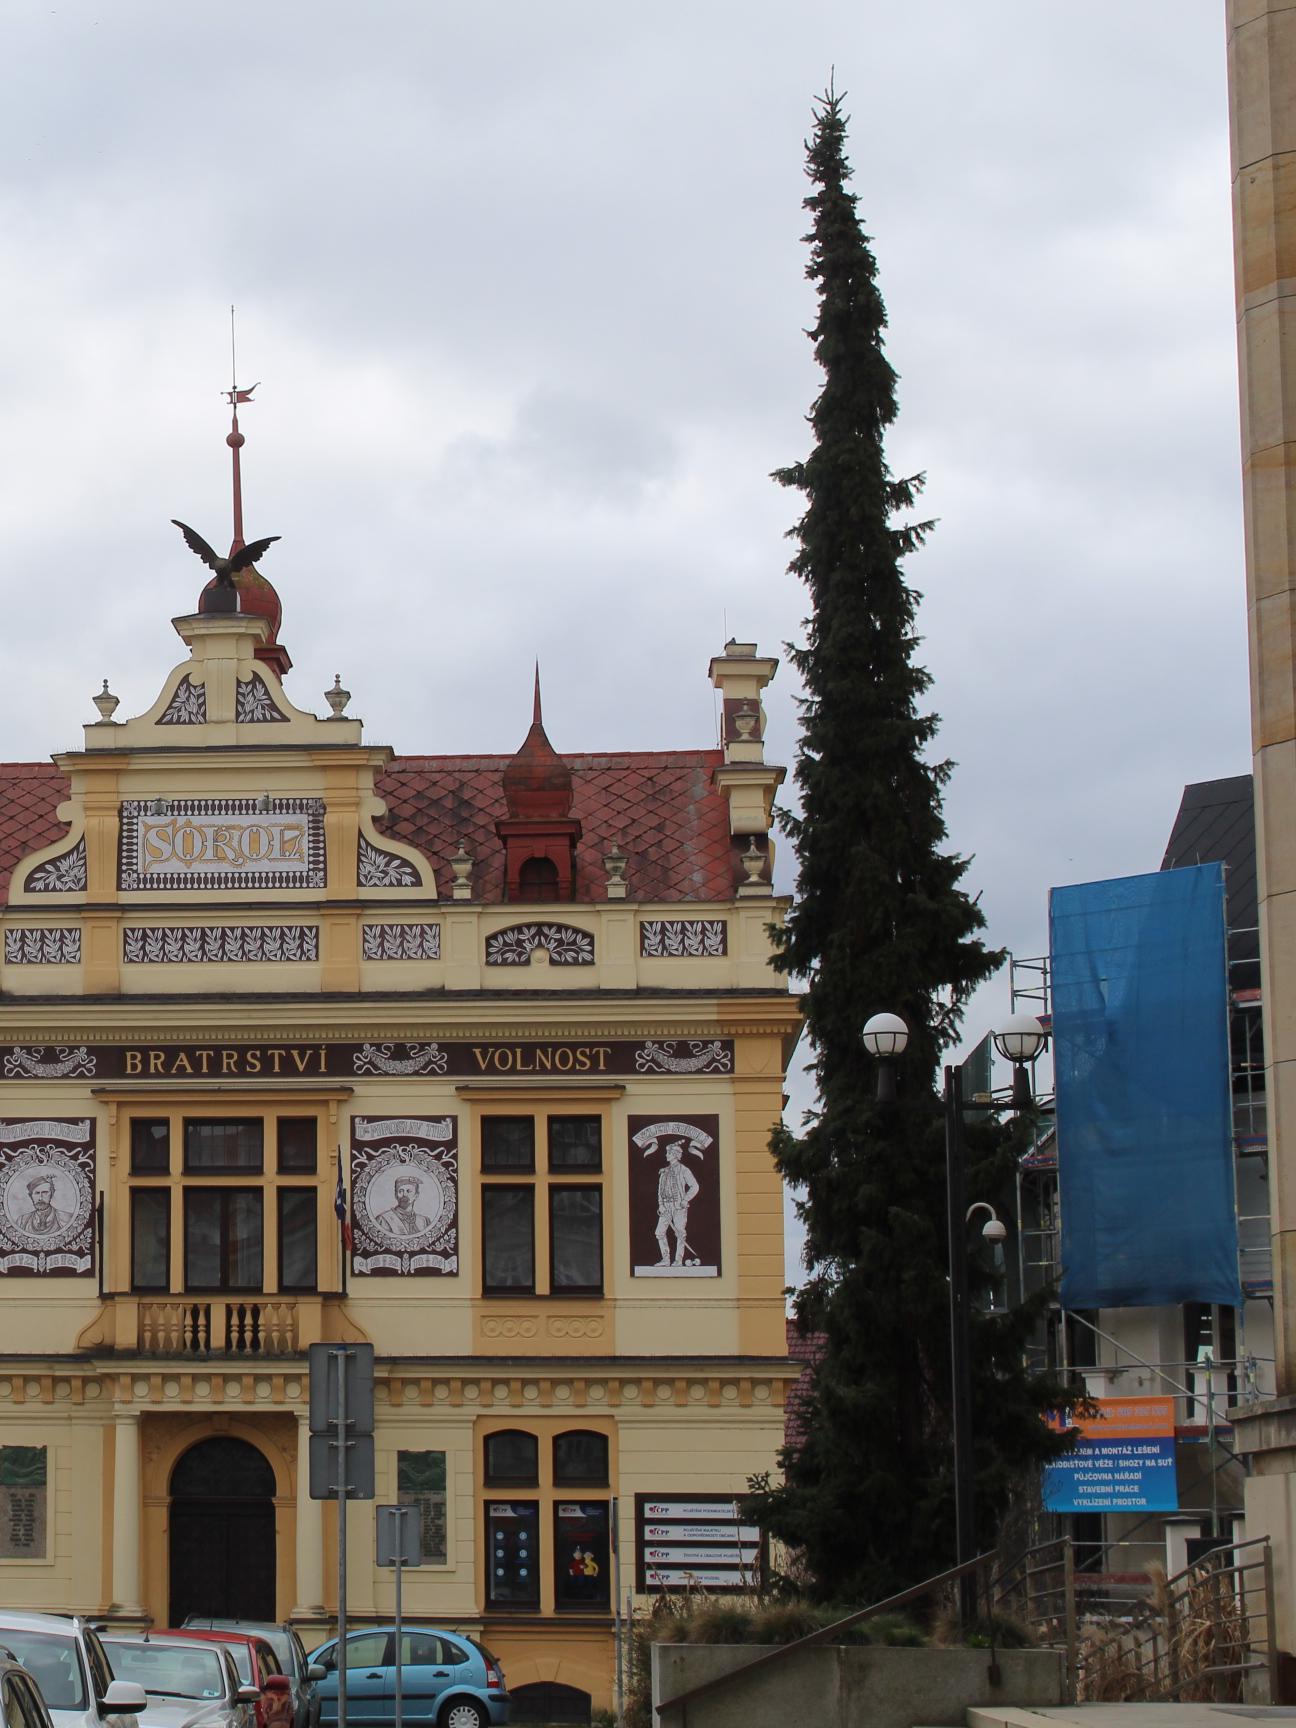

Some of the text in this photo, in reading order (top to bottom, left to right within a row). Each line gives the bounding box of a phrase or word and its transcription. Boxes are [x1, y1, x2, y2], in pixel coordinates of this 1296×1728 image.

[143, 822, 304, 868] SOKOL
[125, 1045, 328, 1074] BRATRSTVÍ
[472, 1048, 612, 1070] VOLNOST
[1101, 1446, 1132, 1455] MONTÁŽ
[1134, 1445, 1160, 1454] LEŠENÍ
[1119, 1459, 1144, 1467] SHOZY
[1074, 1471, 1142, 1480] PŮJČOVNA NÁŘADÍ
[1078, 1485, 1113, 1493] STAVEBNÍ
[1073, 1497, 1111, 1506] VYKLÍZENÍ
